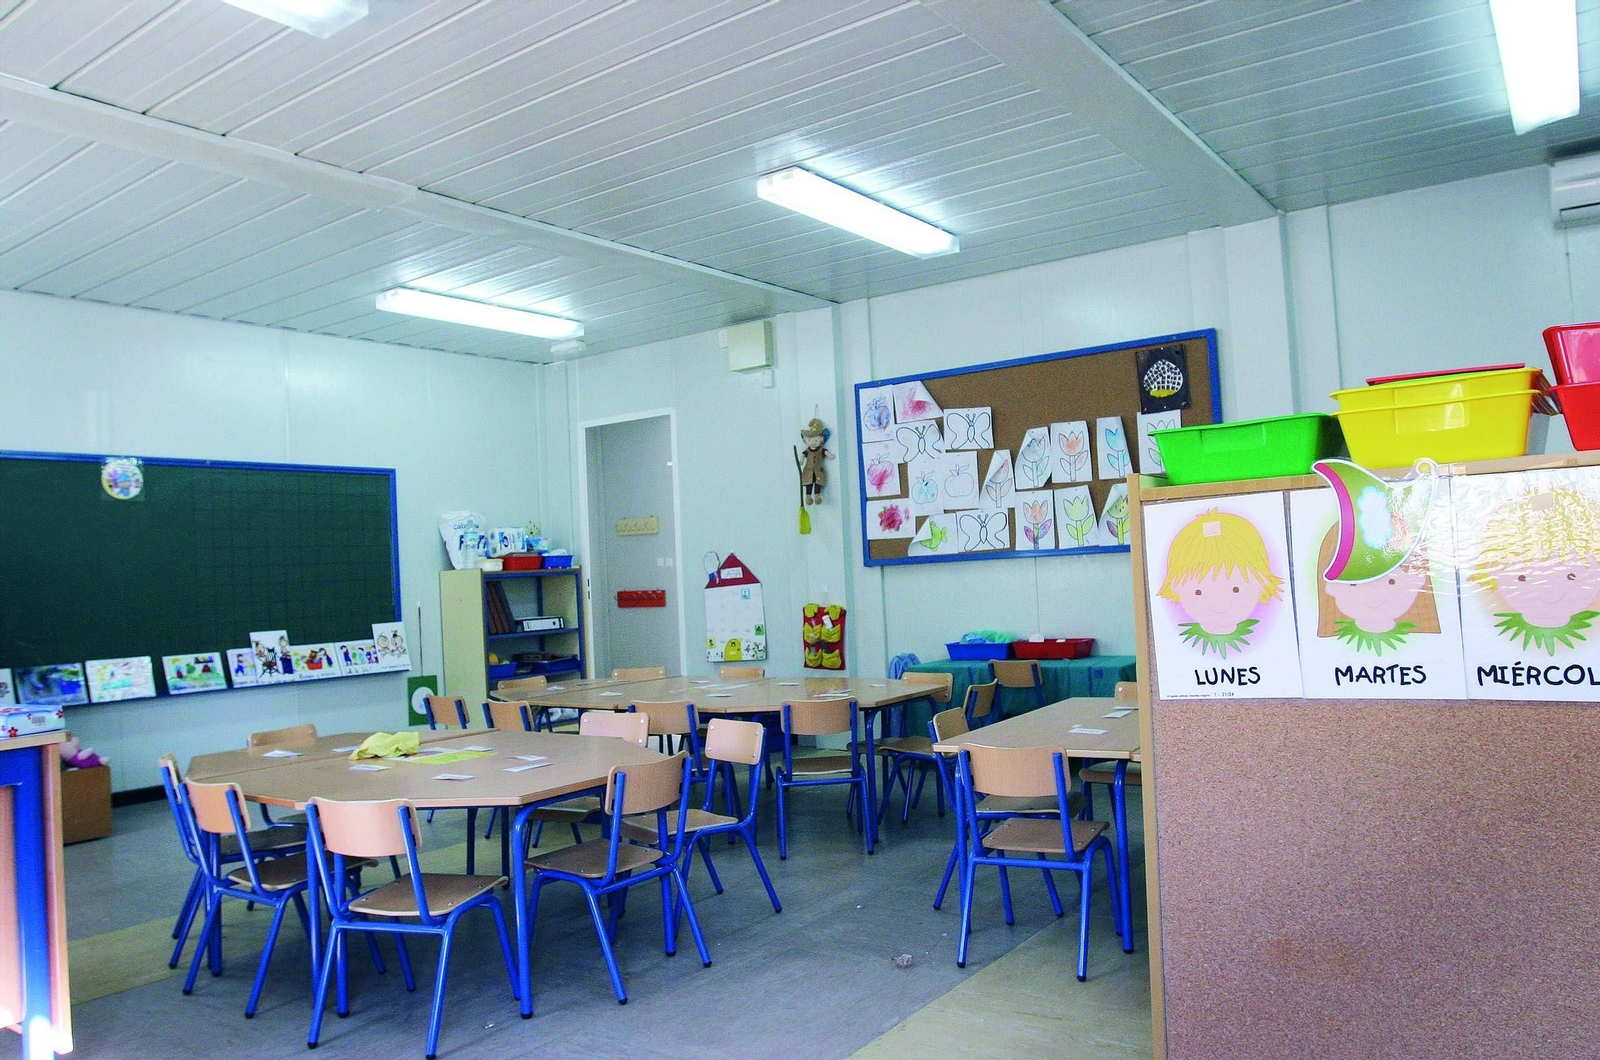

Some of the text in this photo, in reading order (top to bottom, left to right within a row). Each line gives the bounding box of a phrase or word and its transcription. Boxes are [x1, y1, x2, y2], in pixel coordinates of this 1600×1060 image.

[1194, 666, 1261, 686] LUNES
[1334, 664, 1427, 686] MARTES
[1477, 661, 1600, 686] MIÉRCOL
